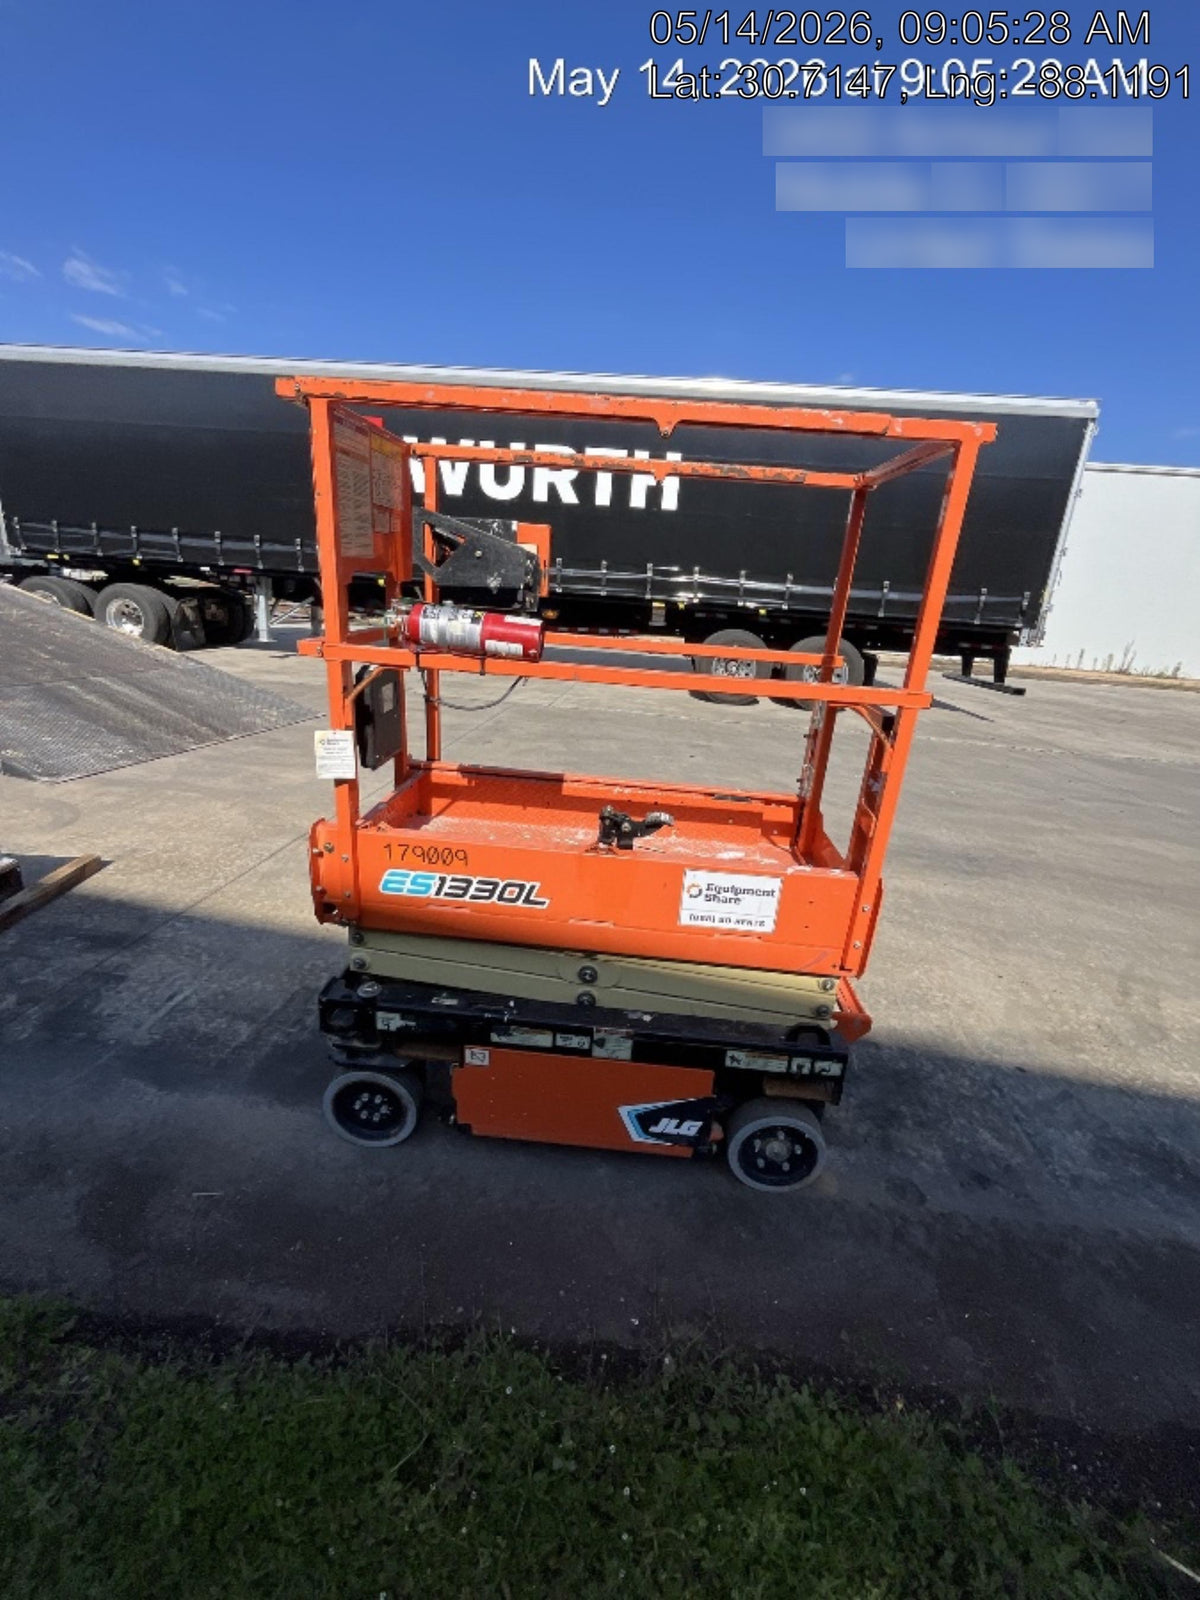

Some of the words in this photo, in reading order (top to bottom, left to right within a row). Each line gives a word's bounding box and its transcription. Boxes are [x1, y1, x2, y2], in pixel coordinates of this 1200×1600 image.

[383, 843, 469, 867] 179009
[380, 869, 549, 908] ES1330L
[705, 883, 776, 898] Equipment
[704, 893, 742, 906] Share
[649, 1118, 703, 1137] JLG
